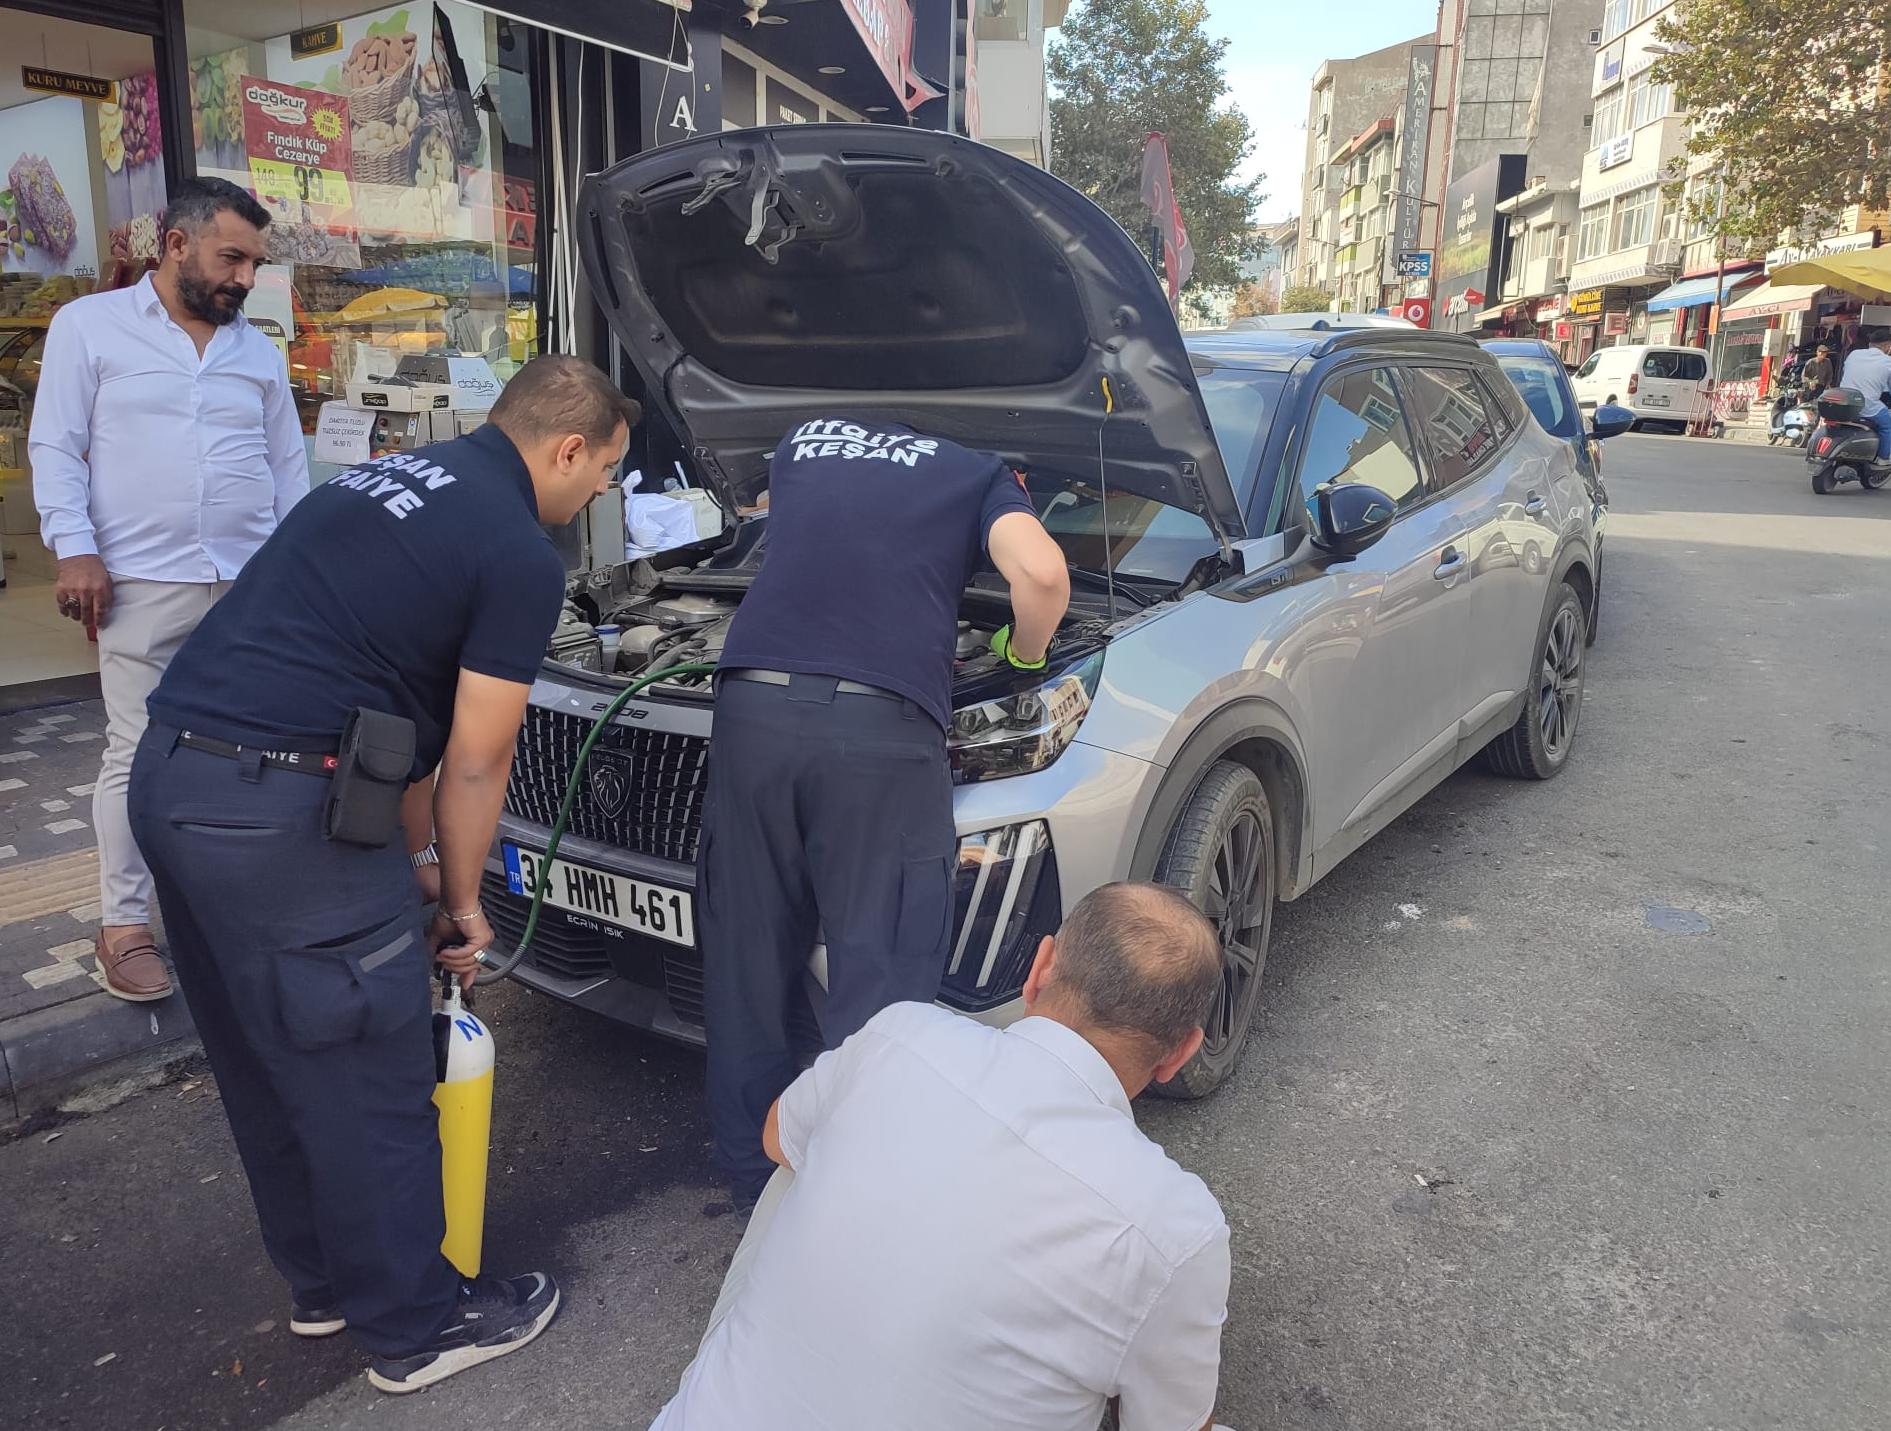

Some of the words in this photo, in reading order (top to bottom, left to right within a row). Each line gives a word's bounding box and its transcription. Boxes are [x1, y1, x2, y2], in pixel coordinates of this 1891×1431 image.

[27, 72, 61, 87] KURU
[64, 78, 106, 94] MEYVE
[669, 95, 698, 132] A
[267, 132, 302, 148] Fındık
[305, 138, 327, 154] Küp
[275, 146, 320, 165] Cezerye
[1399, 261, 1428, 272] KPSS
[793, 441, 920, 467] KEŞAN
[367, 453, 458, 490] EŞAN
[327, 469, 425, 520] FAİYE
[590, 702, 649, 720] 208
[509, 870, 521, 884] TR
[563, 865, 619, 918] HMH
[630, 883, 683, 938] 461
